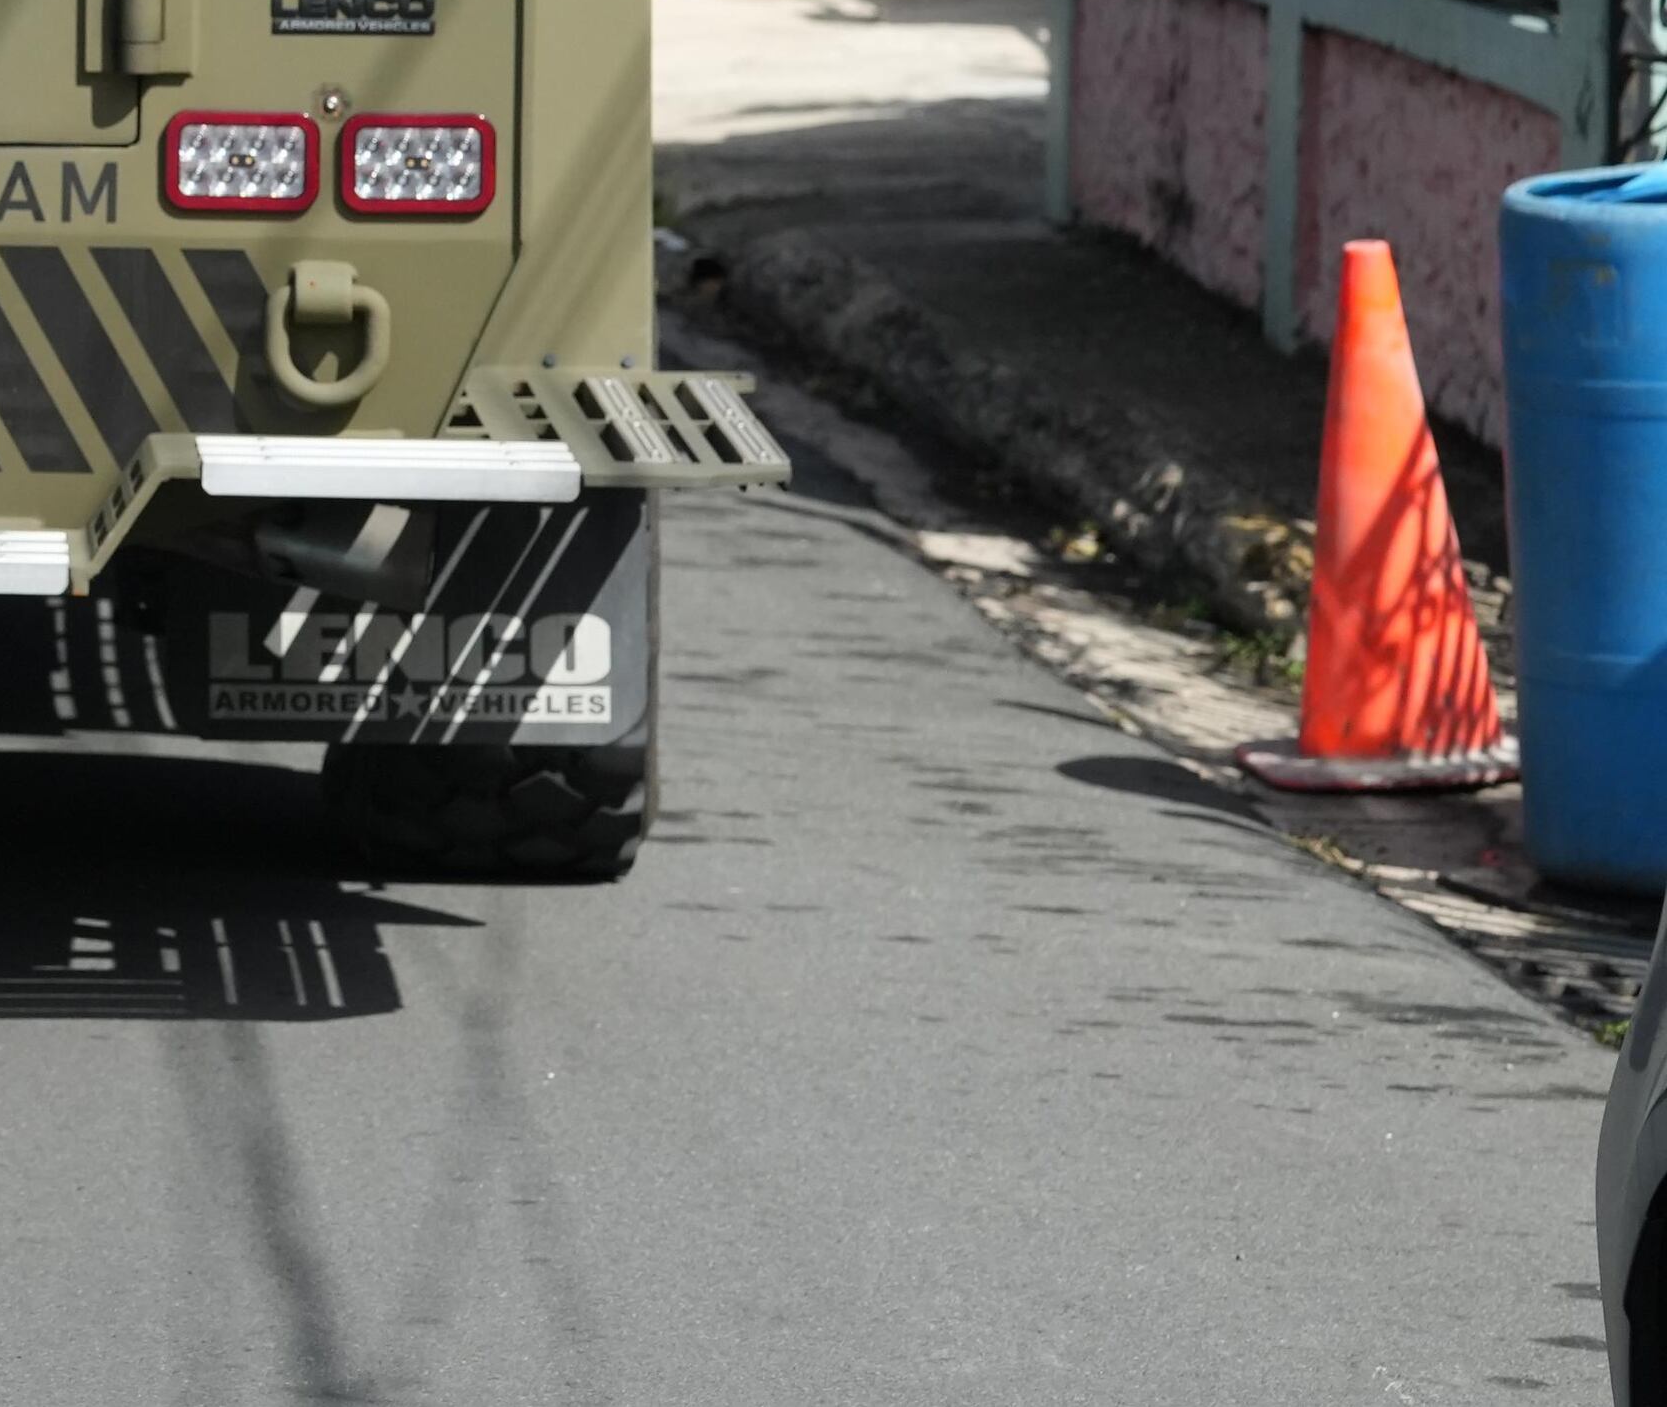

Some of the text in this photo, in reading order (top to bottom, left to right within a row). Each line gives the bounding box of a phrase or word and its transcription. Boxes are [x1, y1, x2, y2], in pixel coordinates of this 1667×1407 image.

[209, 612, 611, 685] LENCO
[215, 691, 606, 716] ARMORED VEHICLES
